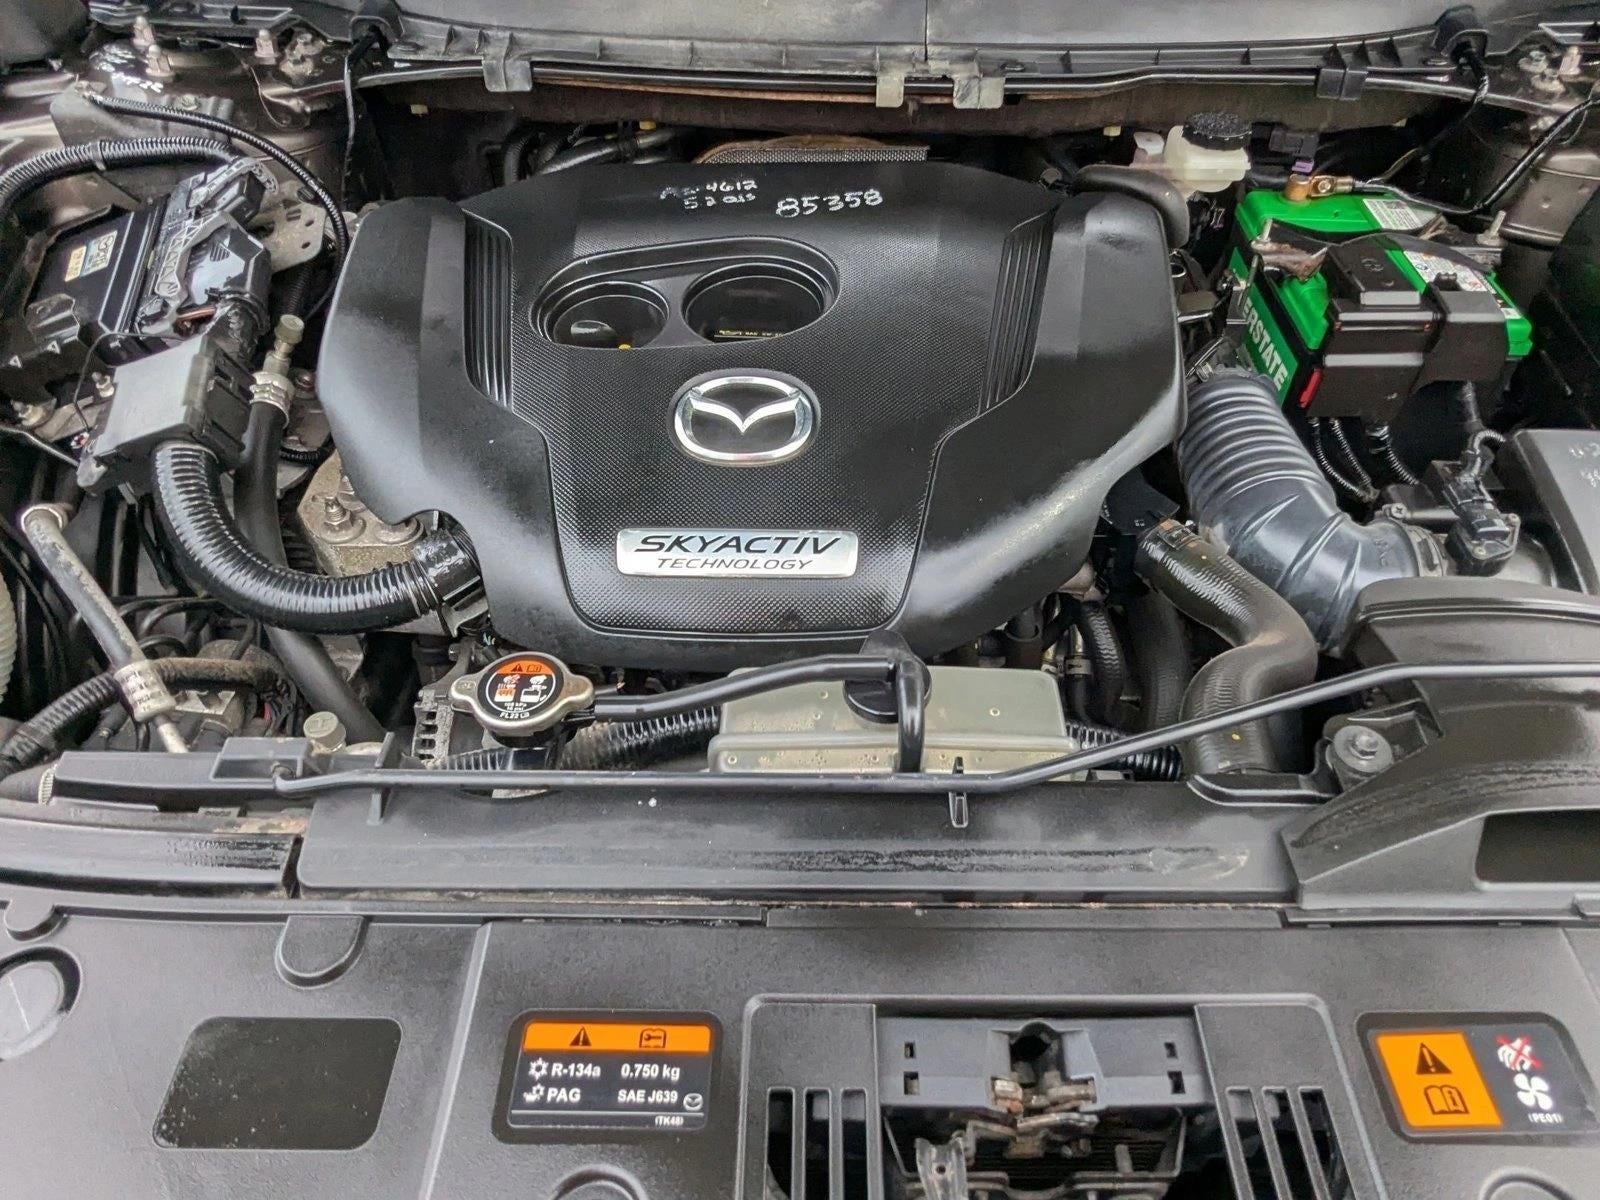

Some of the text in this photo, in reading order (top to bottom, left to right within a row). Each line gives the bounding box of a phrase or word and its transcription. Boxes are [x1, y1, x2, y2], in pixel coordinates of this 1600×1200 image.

[775, 188, 884, 218] 85358
[633, 534, 842, 555] SKYACTIV
[657, 557, 814, 570] TECHNOLOGY
[551, 1062, 681, 1082] R-134a 0.750 kg
[546, 1087, 679, 1103] PAG SAE J639
